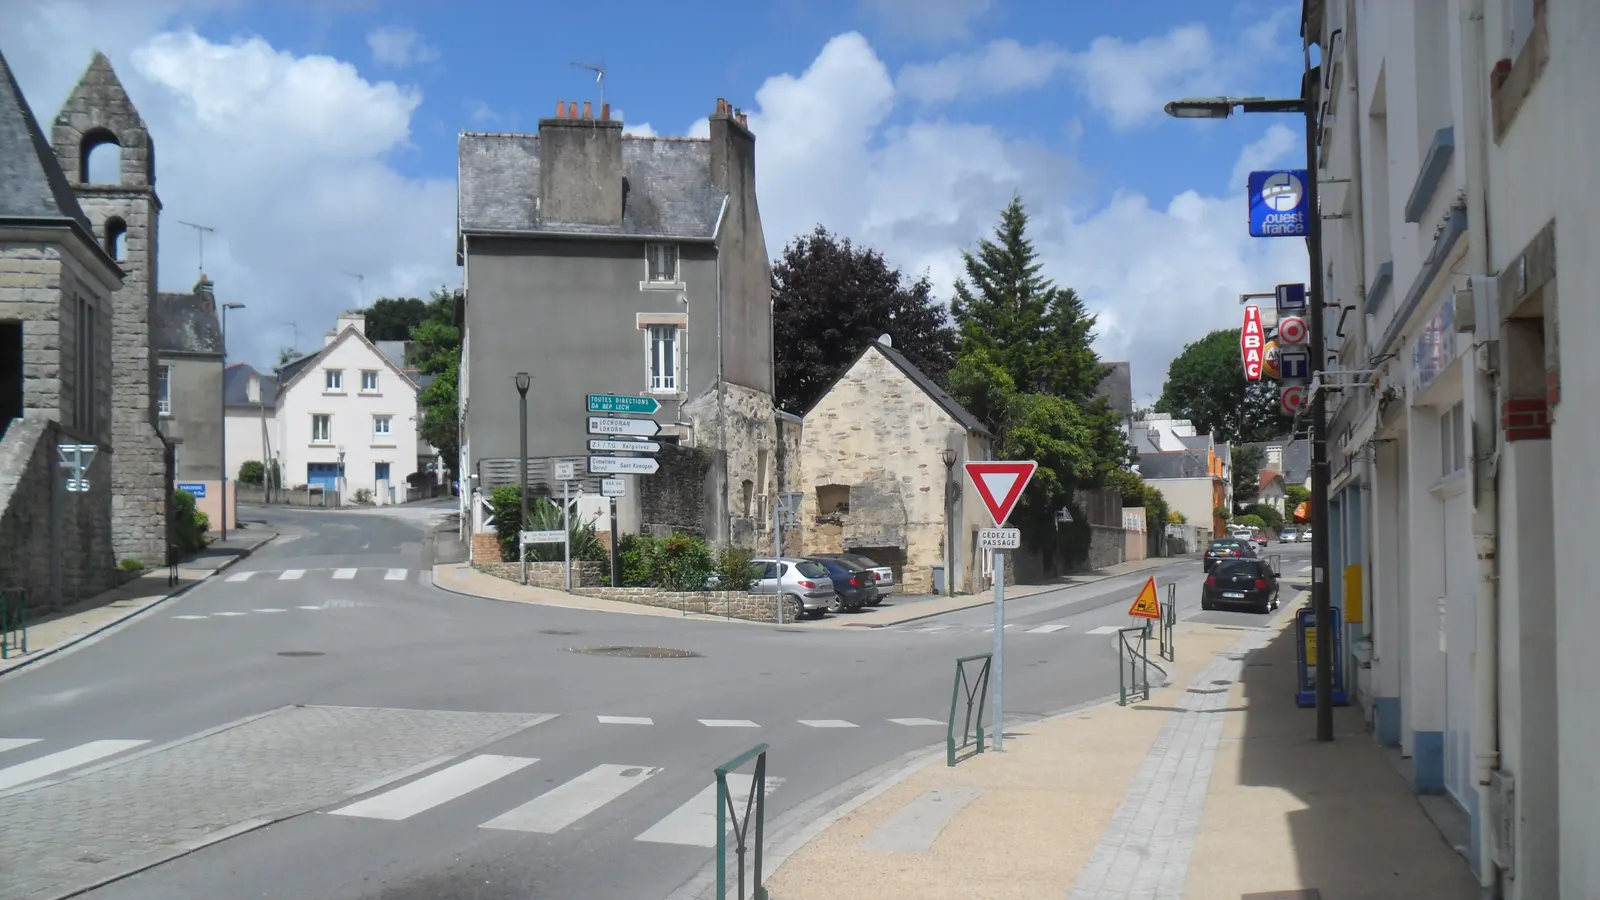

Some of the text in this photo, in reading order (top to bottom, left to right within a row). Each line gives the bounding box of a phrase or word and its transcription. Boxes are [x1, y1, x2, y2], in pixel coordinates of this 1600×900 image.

[1265, 211, 1304, 224] ouest
[1262, 221, 1304, 234] france
[1245, 307, 1260, 377] TABAC
[615, 398, 649, 406] DIRECTIONS
[982, 531, 1005, 539] CÉDEZ
